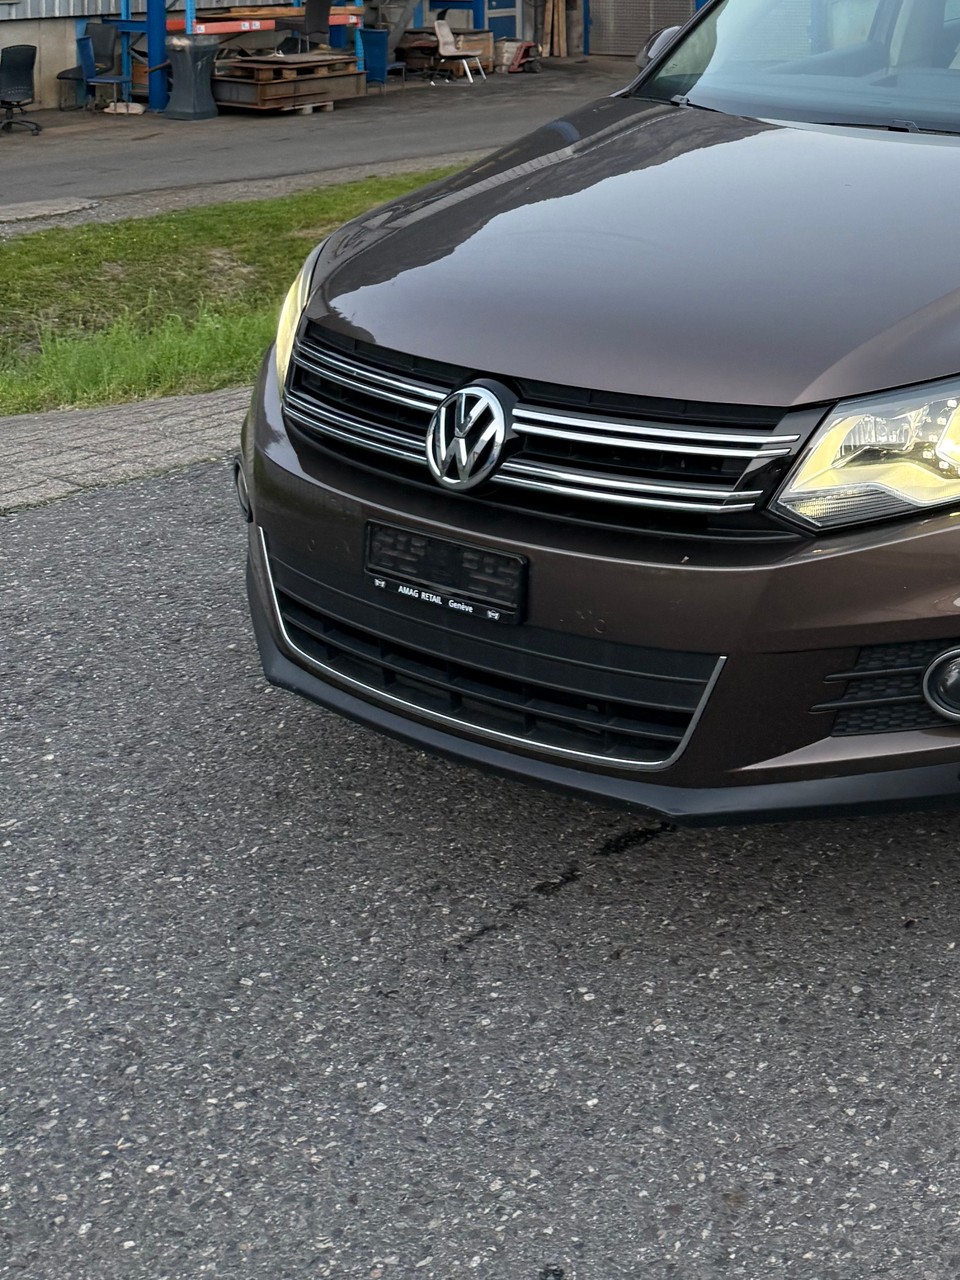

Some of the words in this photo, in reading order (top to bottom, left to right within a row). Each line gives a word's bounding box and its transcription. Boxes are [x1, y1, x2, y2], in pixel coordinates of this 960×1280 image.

[429, 387, 503, 488] VW
[398, 585, 419, 598] AMAG
[421, 591, 442, 605] RETAIL
